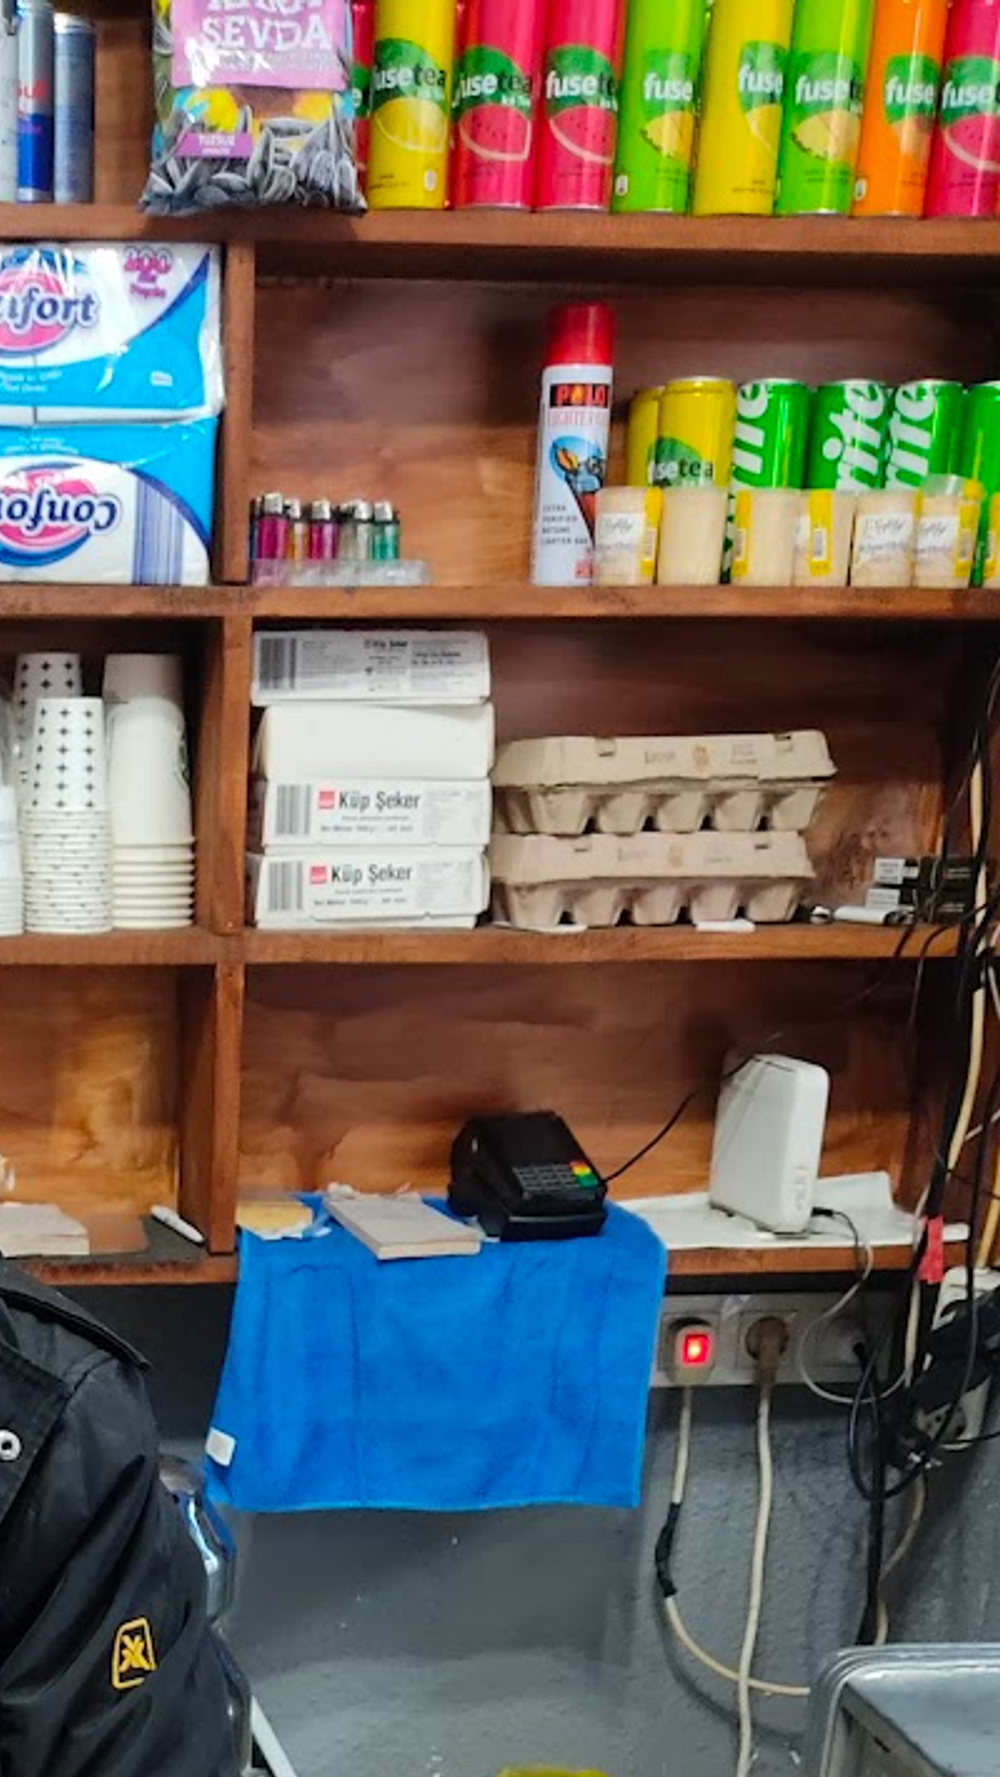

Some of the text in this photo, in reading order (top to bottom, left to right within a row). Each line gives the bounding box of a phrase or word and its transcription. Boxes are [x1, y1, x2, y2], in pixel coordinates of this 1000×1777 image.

[200, 13, 333, 52] SEVDA
[545, 70, 598, 99] fuse
[643, 72, 694, 101] fuse
[795, 75, 850, 105] fuse
[338, 790, 371, 812] Küp
[376, 790, 421, 812] Şeker
[331, 862, 413, 885] Küp Şeker
